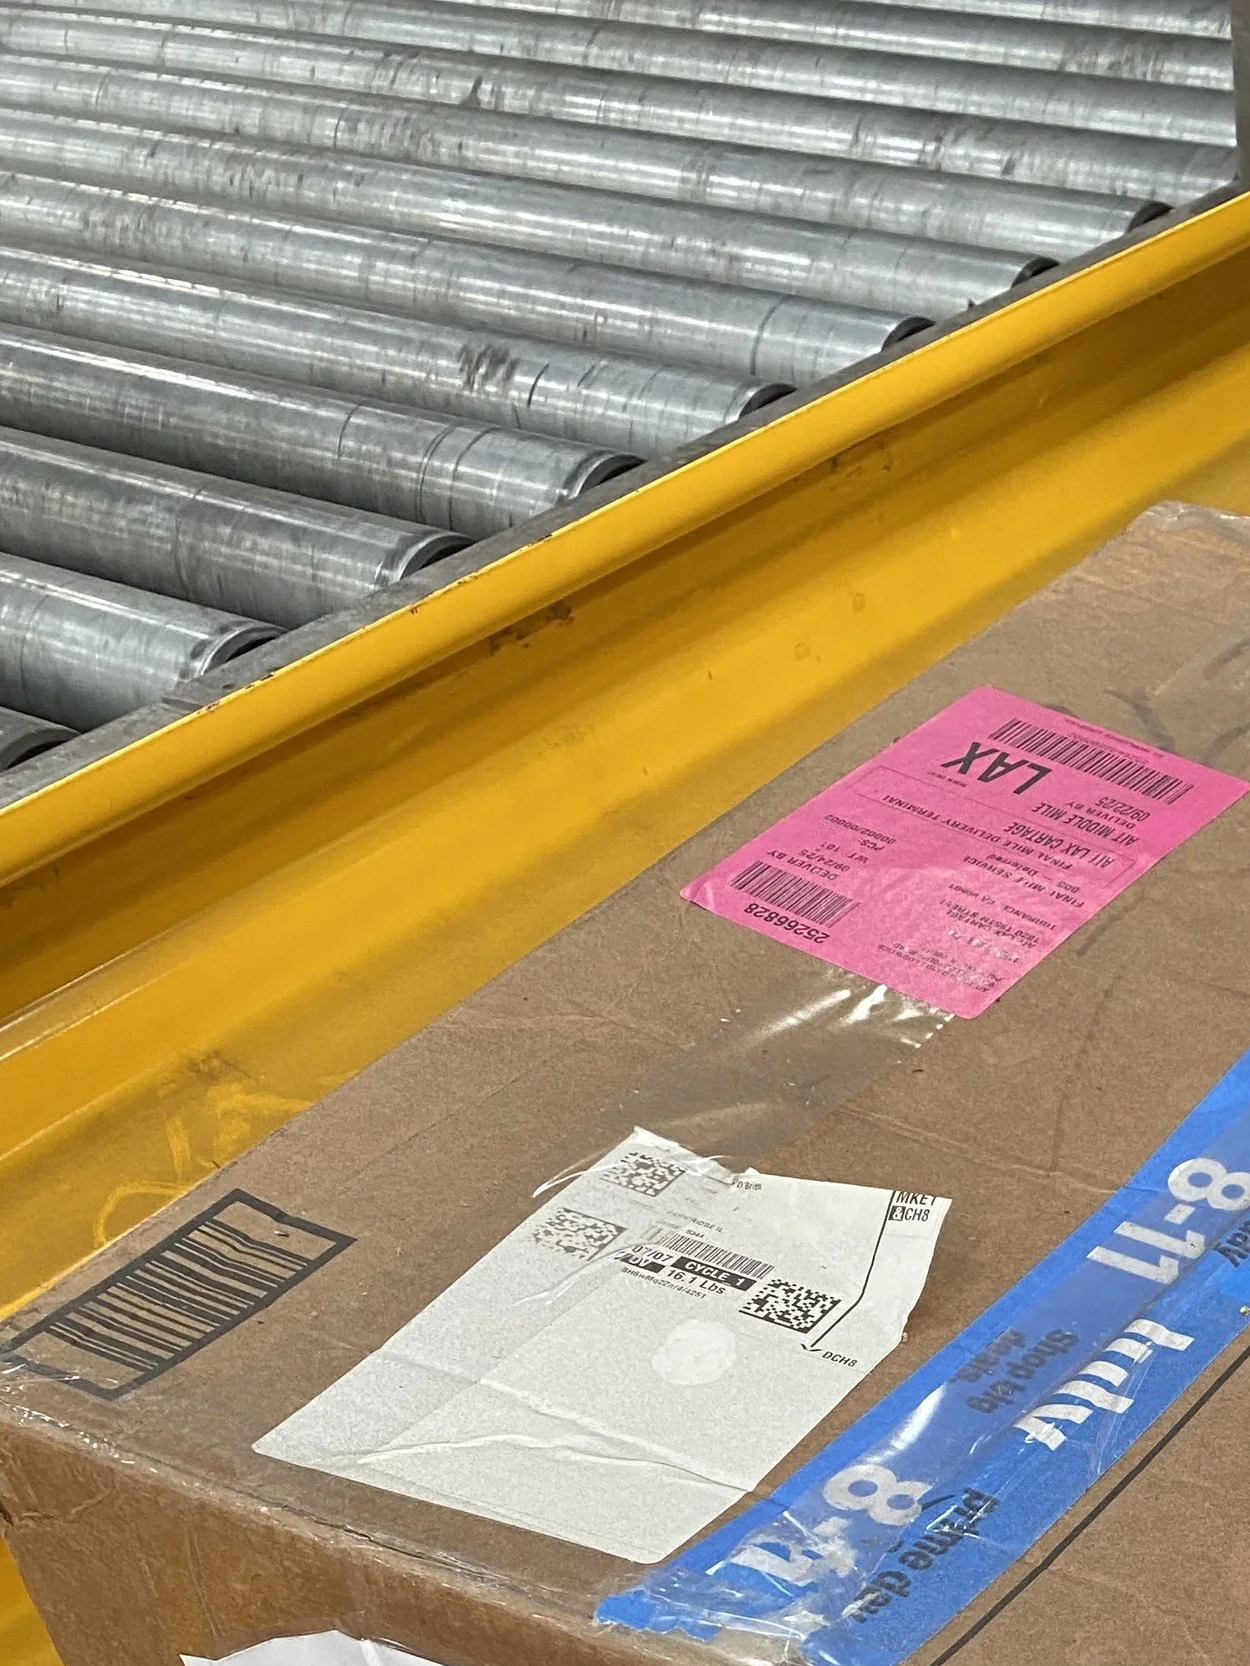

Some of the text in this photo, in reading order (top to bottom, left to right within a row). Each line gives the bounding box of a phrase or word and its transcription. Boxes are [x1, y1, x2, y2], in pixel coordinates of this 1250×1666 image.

[939, 739, 1053, 796] LAX
[1030, 801, 1139, 847] AIT MIDDLE MILE
[1064, 799, 1136, 830] DELIVER BY
[1093, 795, 1151, 823] 09/22/25
[880, 793, 1073, 870] FINAL MILE DELIVERY TERMINAL
[1001, 820, 1115, 869] AIT LAX CARTAGE
[765, 848, 839, 881] DELIVER BY
[740, 901, 832, 944] 25266828
[667, 1269, 698, 1285] 16.1
[700, 1279, 726, 1295] Lbs
[822, 1351, 858, 1367] DCH8
